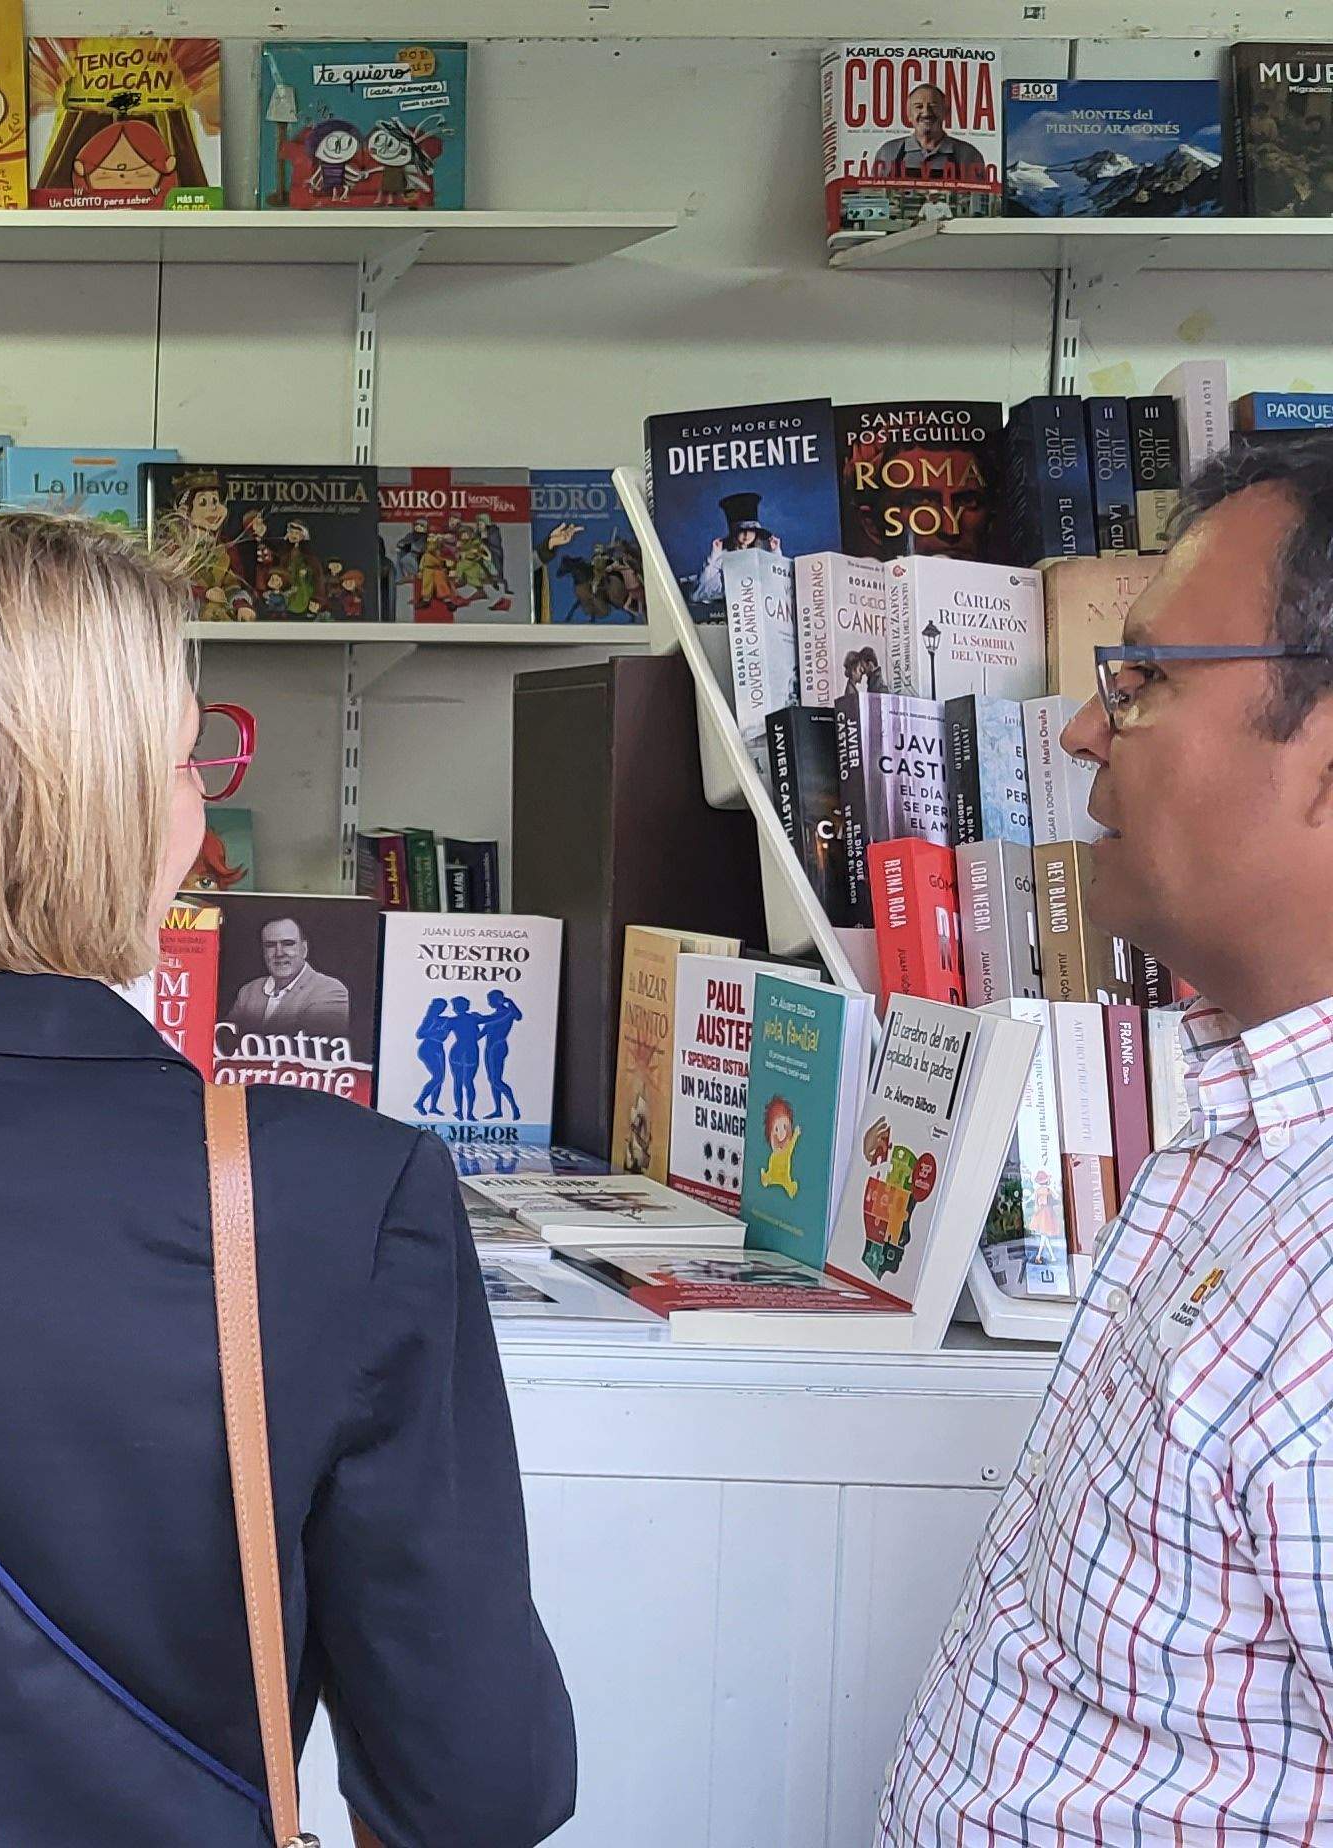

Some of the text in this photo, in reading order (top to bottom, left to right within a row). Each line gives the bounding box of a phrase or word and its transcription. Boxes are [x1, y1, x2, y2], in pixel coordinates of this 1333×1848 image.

[75, 49, 144, 75] TENGO
[846, 47, 997, 62] KARLOS ARGUIÑANO
[82, 65, 174, 94] VOLCÁN
[342, 64, 412, 93] quiero
[1022, 84, 1054, 96] 100
[844, 58, 997, 131] COCINA
[1046, 119, 1181, 136] PIRINEO ARAGONÉS
[1071, 108, 1154, 121] MONTES del
[63, 196, 102, 208] CUENTO
[1202, 379, 1212, 409] ELOY
[681, 417, 803, 439] ELOY MORENO
[860, 409, 972, 430] SANTIAGO
[846, 426, 987, 446] POSTEGUILLO
[667, 433, 821, 477] DIFERENTE
[1044, 427, 1063, 480] ZUECO
[1061, 437, 1079, 470] LUIS
[1095, 427, 1112, 481] ZUECO
[1111, 438, 1127, 470] LUIS
[1138, 427, 1157, 481] ZUECO
[1155, 437, 1171, 470] LUIS
[33, 470, 129, 497] La llave
[853, 457, 987, 491] ROMA
[225, 479, 370, 504] PETRONILA
[1058, 497, 1072, 513] EL
[883, 504, 966, 538] SOY
[953, 590, 1012, 612] CARLOS
[811, 560, 829, 675] SOBRE CANFRANC
[938, 608, 1029, 635] RUIZ ZAFÓN
[731, 603, 747, 687] ROSARIO RARO
[740, 576, 764, 709] VOLVER CANFRANC
[802, 606, 815, 692] ROSARIO RARO
[952, 633, 1016, 652] LA SOMBRA
[950, 650, 1019, 667] DEL VIENTO
[773, 723, 789, 779] JAVIER
[836, 711, 849, 782] CASTILLO
[846, 717, 861, 769] JAVIER
[1038, 708, 1052, 765] María Oruña
[899, 785, 944, 801] EL DÍA
[910, 817, 927, 829] EL
[956, 793, 965, 826] PERDIÓ
[844, 819, 855, 858] PERDIÓ
[853, 837, 863, 858] DÍA
[882, 859, 908, 929] REINA ROJA
[970, 860, 992, 975] LOBA NEGRA JUAN
[1046, 860, 1070, 974] REY BLANCO JUAN
[421, 927, 529, 939] JUAN LUIS ARSUAGA
[416, 943, 531, 963] NUESTRO
[425, 964, 522, 983] CUERPO
[706, 978, 746, 1015] PAUL
[212, 1021, 353, 1064] Contra
[892, 1011, 960, 1054] El cerebro del niño
[1118, 1020, 1134, 1065] FRANK
[687, 1051, 721, 1075] SPENCER
[920, 1050, 954, 1084] los padres
[681, 1074, 723, 1103] UN PAÍS
[893, 1085, 937, 1115] Álvaro Bilbao
[695, 1106, 708, 1128] EN
[446, 1125, 520, 1142] MEJOR
